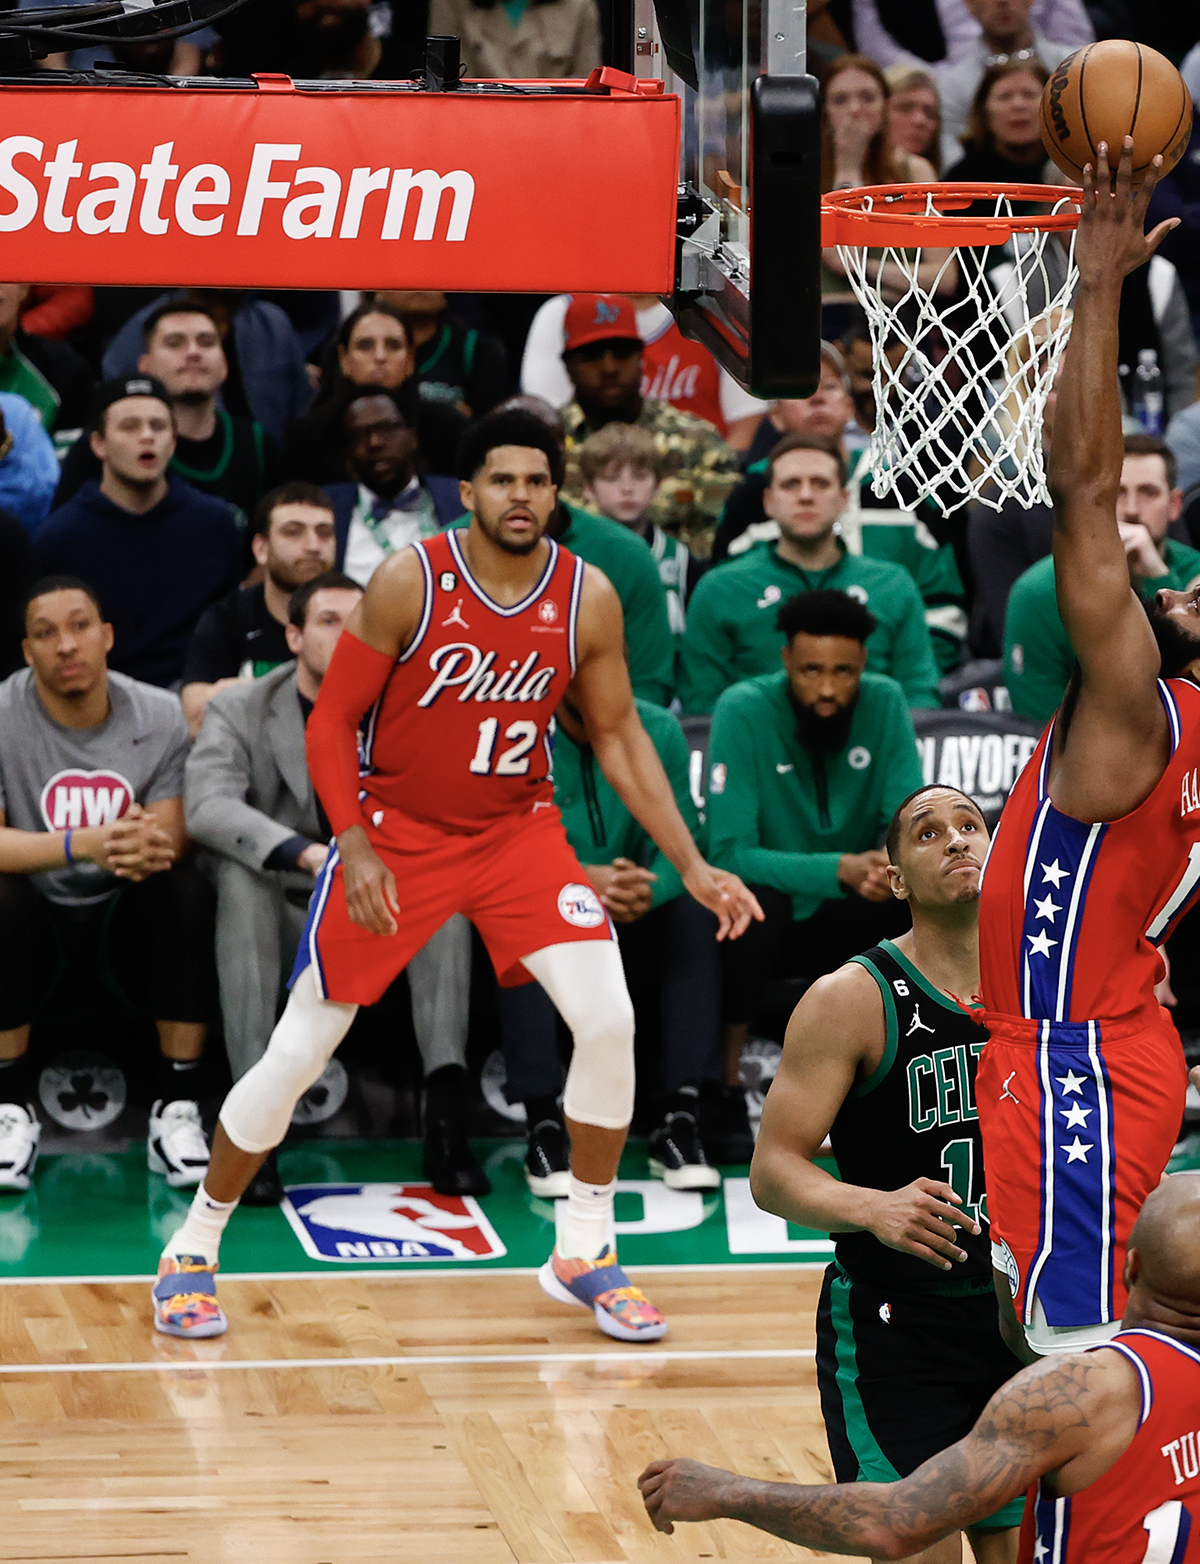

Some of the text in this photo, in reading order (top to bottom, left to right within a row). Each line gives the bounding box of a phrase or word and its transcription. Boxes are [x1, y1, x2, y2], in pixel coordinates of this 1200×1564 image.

[440, 572, 456, 592] 6
[417, 642, 556, 707] Phila
[469, 717, 538, 775] 12
[54, 786, 126, 828] HW
[893, 979, 910, 997] 6
[335, 1241, 430, 1257] NBA
